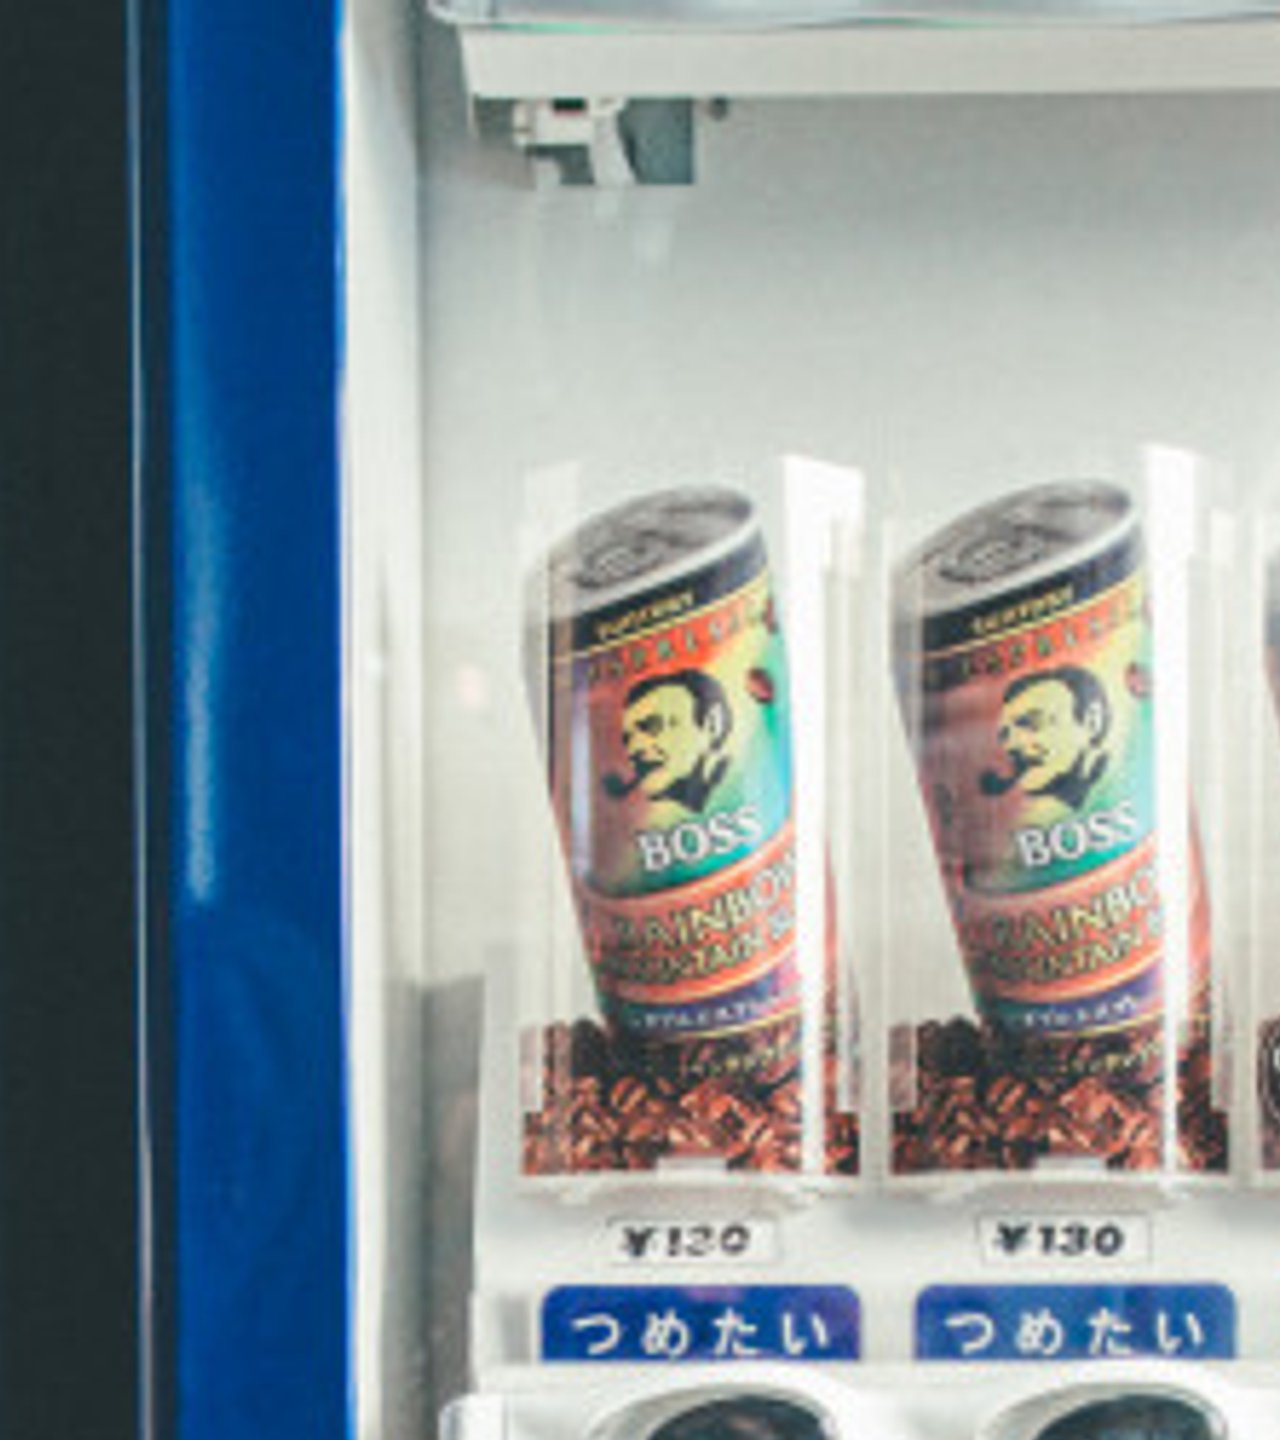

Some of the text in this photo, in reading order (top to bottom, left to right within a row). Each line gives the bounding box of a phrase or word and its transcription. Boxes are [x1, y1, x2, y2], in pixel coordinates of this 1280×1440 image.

[634, 806, 764, 873] BOSS
[1016, 803, 1140, 867] BOSS
[993, 1223, 1125, 1255] ¥130
[572, 1309, 829, 1357] つめたい
[944, 1308, 1205, 1357] つめたい
